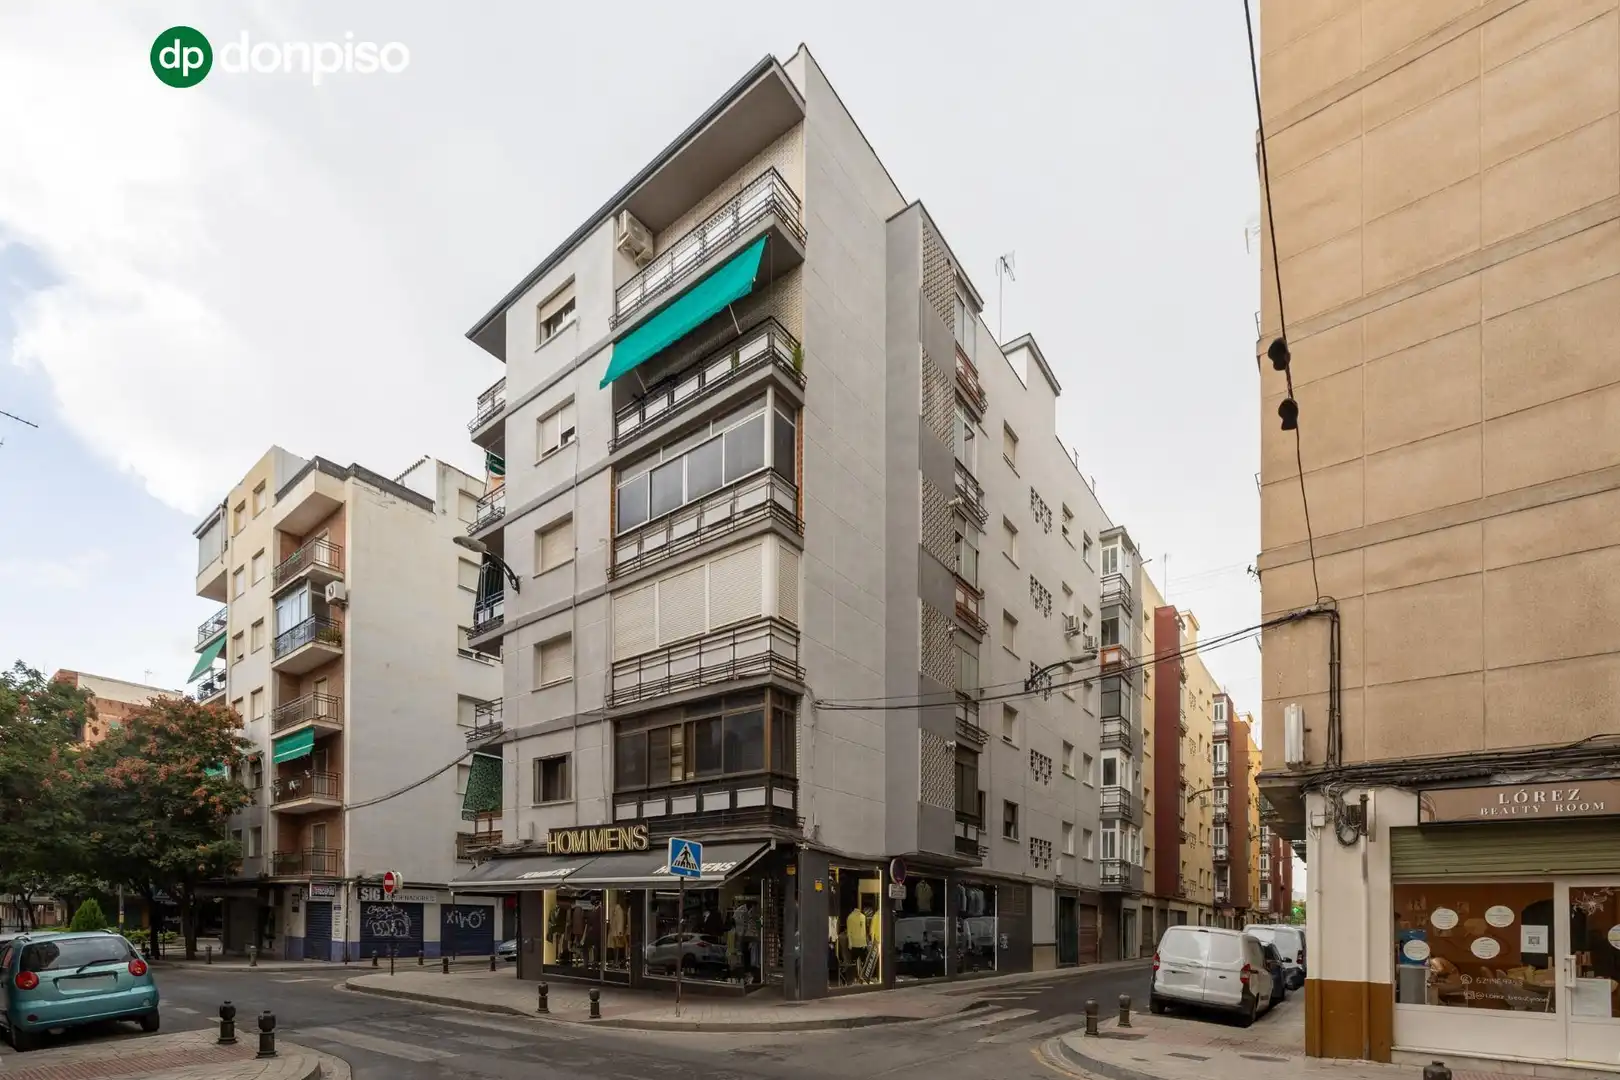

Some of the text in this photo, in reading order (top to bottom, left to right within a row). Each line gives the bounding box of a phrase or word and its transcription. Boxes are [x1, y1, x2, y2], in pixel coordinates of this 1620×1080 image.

[1498, 788, 1581, 805] LÓREZ
[1480, 801, 1605, 816] BEAUTY ROOM
